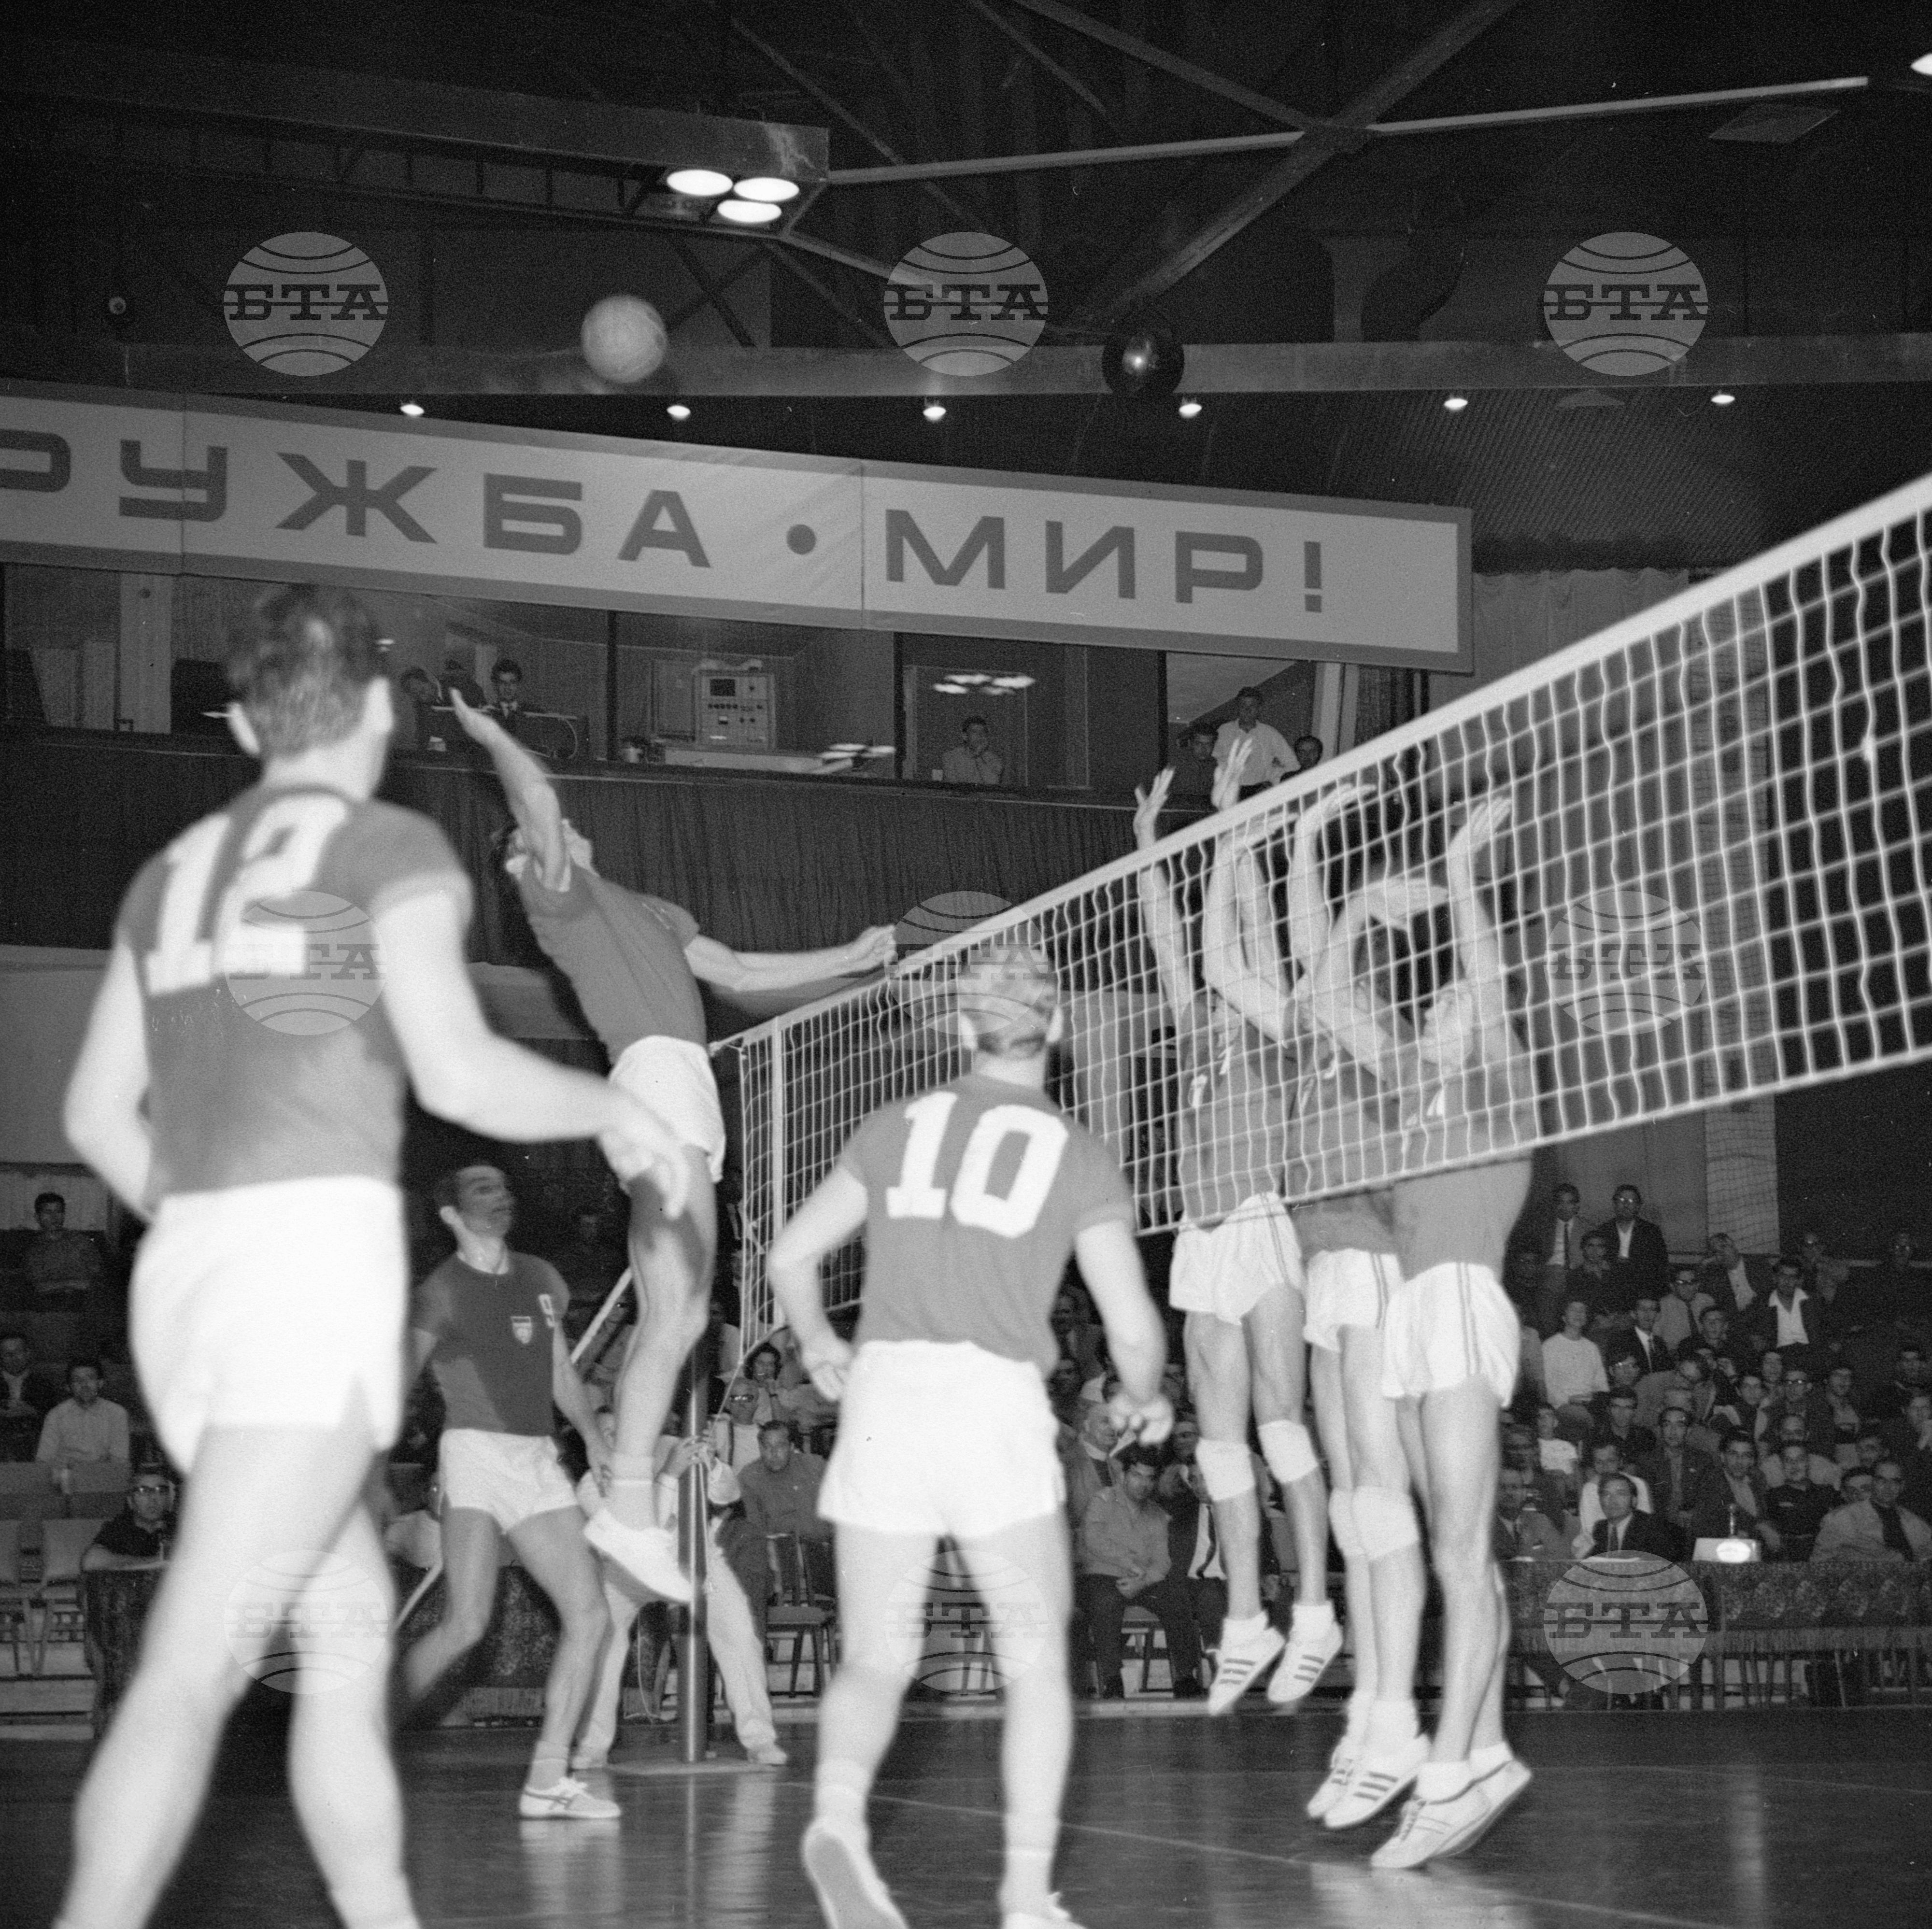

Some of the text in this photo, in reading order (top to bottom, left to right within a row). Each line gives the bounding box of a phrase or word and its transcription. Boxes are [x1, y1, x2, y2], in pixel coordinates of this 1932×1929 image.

[885, 509, 1322, 612] МИР!
[144, 795, 348, 997] 12
[886, 1091, 1069, 1238] 10
